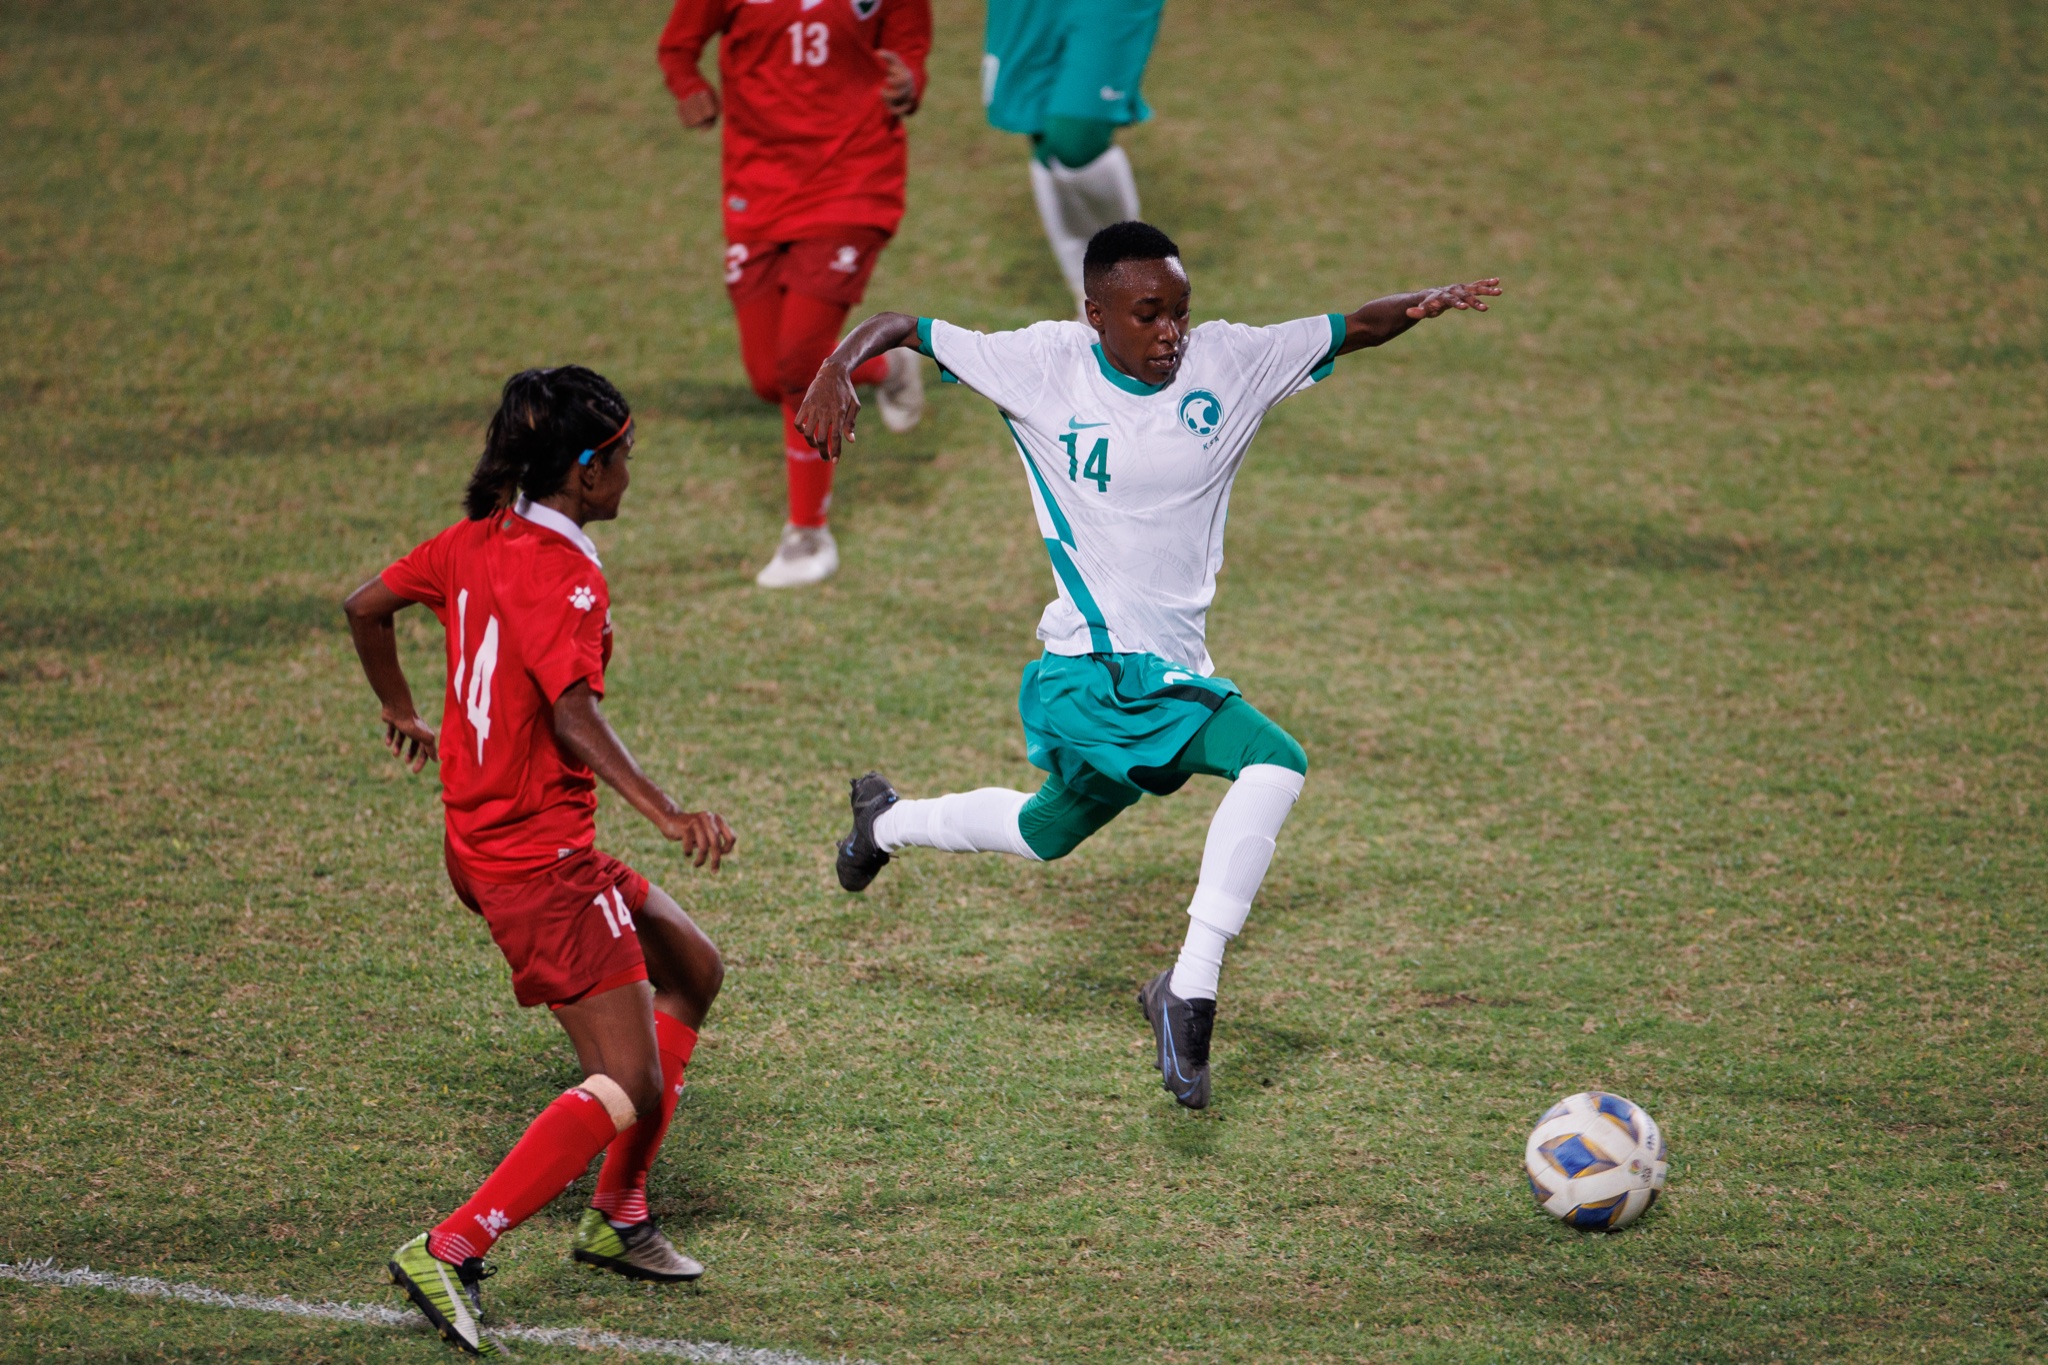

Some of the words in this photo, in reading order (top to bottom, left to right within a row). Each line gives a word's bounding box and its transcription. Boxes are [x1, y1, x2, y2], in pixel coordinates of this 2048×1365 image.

[787, 22, 829, 67] 13
[1059, 432, 1111, 493] 14
[454, 588, 499, 767] 14
[593, 885, 637, 938] 14
